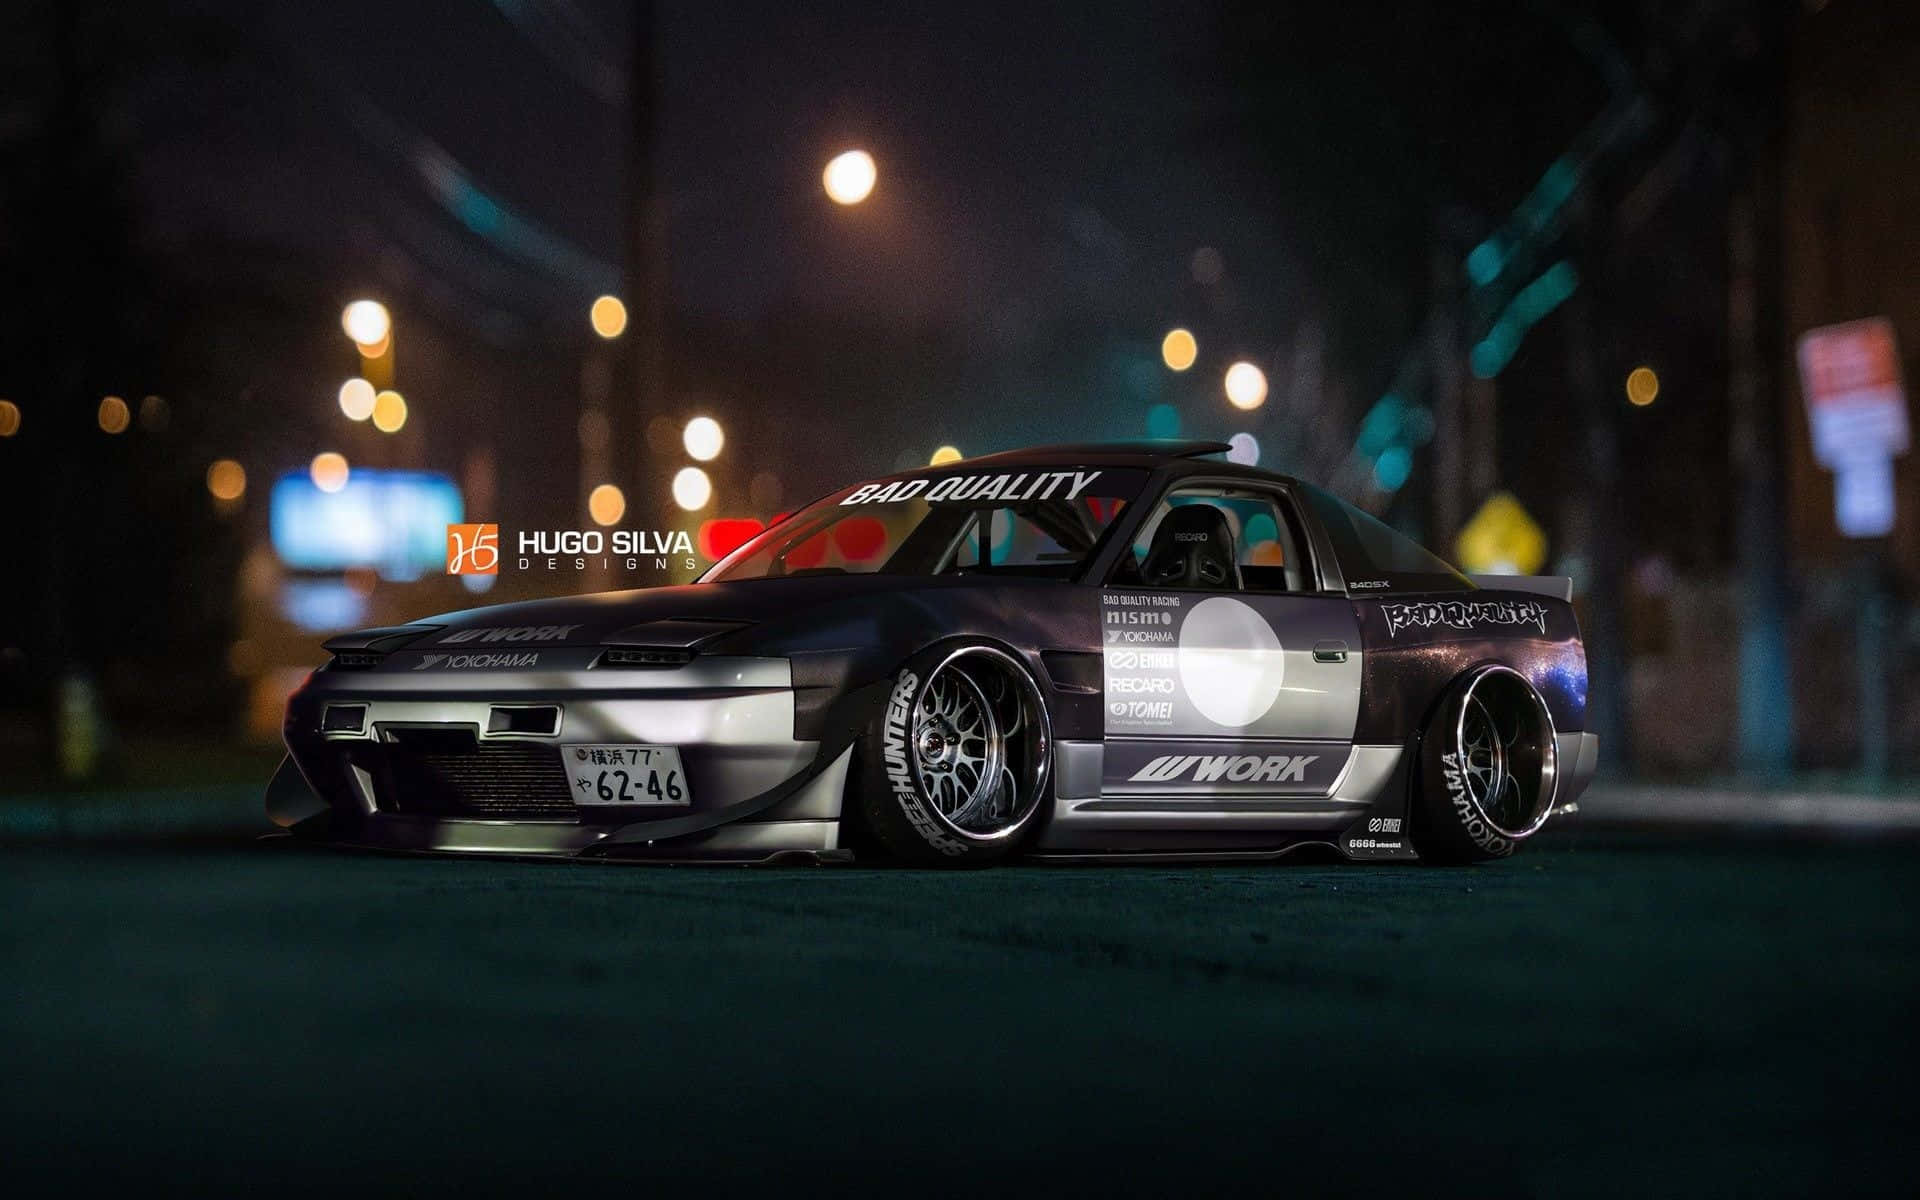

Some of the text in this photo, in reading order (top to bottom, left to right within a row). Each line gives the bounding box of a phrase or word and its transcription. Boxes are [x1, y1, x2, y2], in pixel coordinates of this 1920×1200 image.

[839, 471, 1102, 507] BAD QUALITY
[1103, 595, 1180, 607] BAD QUALITY RACING
[1123, 631, 1175, 642] YOKOHAMA
[446, 653, 539, 668] YOKOHAMA
[1109, 678, 1175, 694] RECARO
[1128, 702, 1173, 719] TOMEI
[1192, 755, 1320, 782] WORK
[597, 770, 682, 801] 62-46
